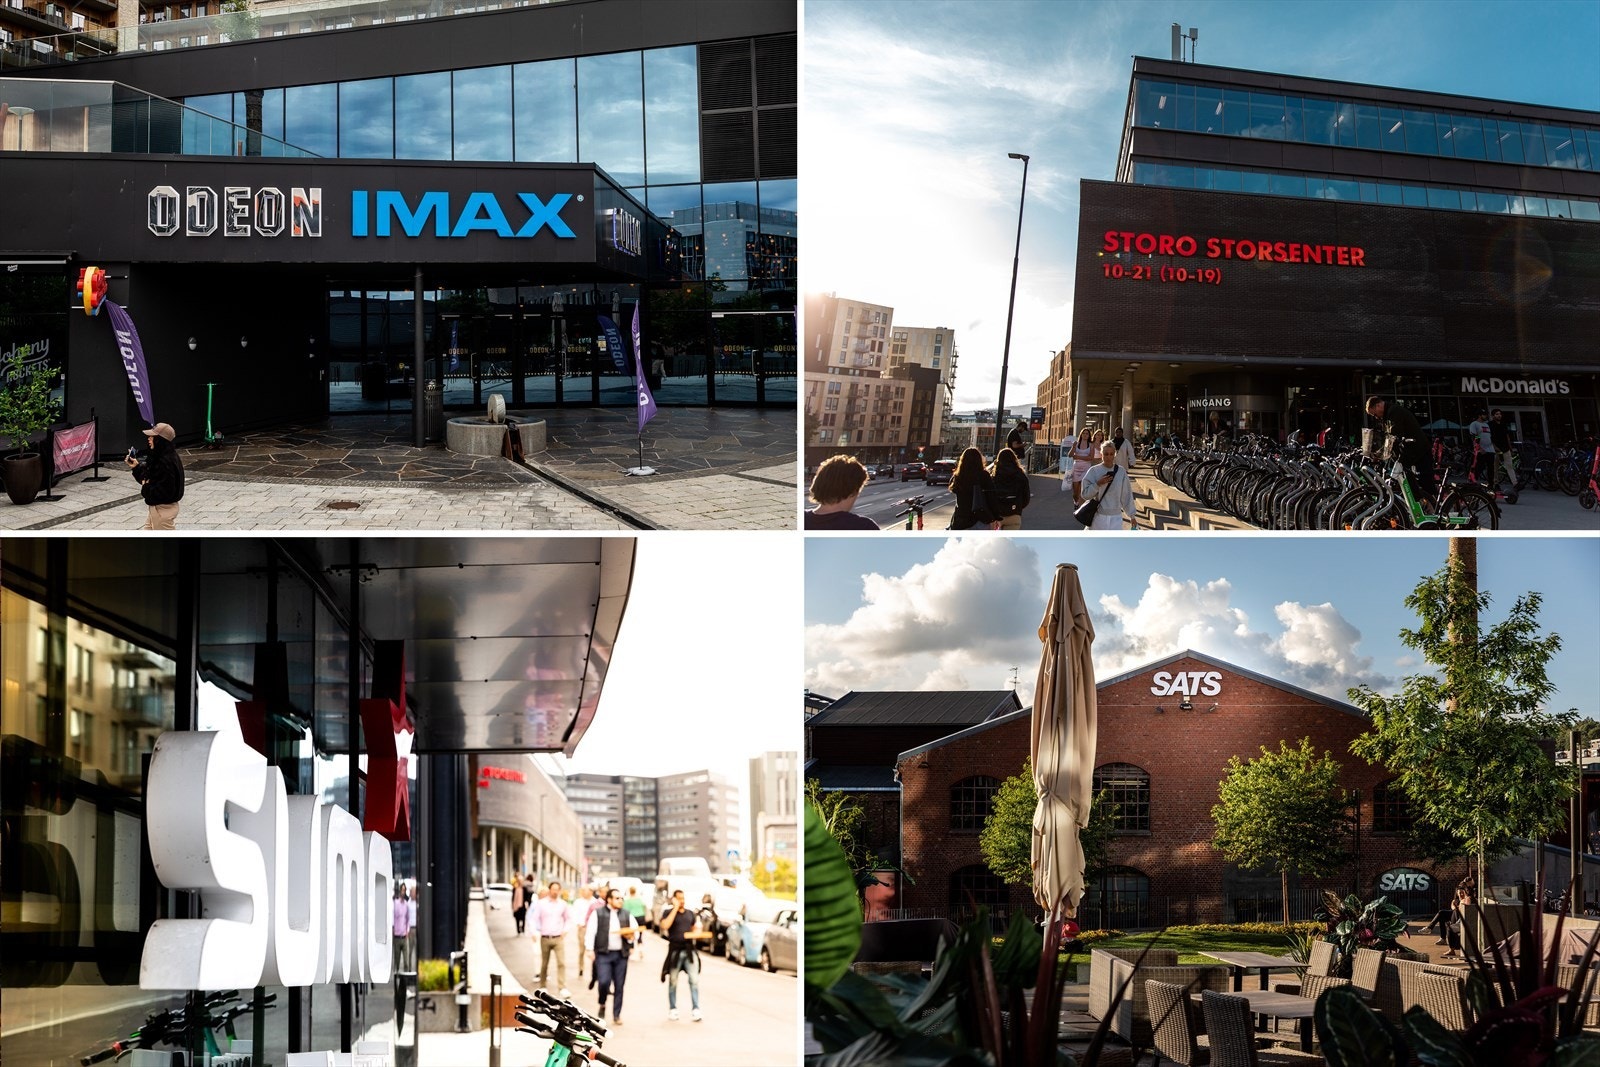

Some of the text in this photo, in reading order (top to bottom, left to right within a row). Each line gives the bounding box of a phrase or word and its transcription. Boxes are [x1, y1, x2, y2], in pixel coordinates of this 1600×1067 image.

[147, 185, 322, 238] ODEON
[1103, 230, 1366, 267] STORO STORSENTER
[1102, 263, 1222, 285] 10-21 (10-19)
[6, 358, 50, 384] ROCKTS
[1461, 376, 1570, 395] McDonald's
[1189, 397, 1232, 408] INNGANG
[1150, 671, 1223, 697] SATS
[1379, 873, 1431, 891] SATS
